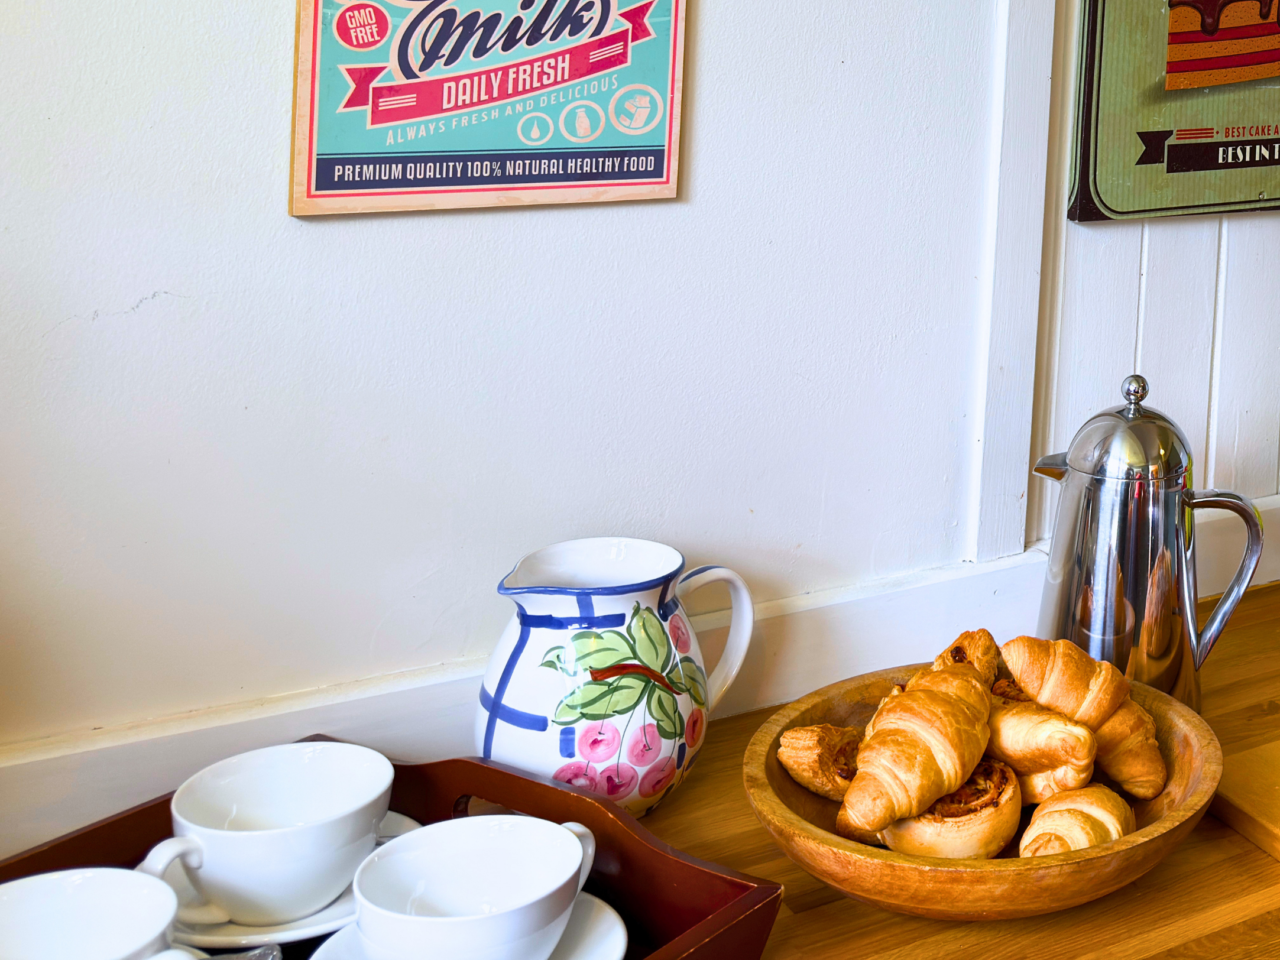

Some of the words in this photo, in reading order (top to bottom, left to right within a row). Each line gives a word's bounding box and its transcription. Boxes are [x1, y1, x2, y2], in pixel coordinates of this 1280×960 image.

[345, 2, 376, 28] GMO
[350, 24, 381, 46] FREE
[442, 70, 503, 110] DAILY
[507, 53, 571, 95] FRESH
[386, 120, 447, 147] ALWAYS
[451, 108, 500, 131] FRESH
[504, 99, 535, 117] AND
[539, 73, 619, 109] DELICIOUS
[1224, 126, 1247, 139] BEST
[1248, 125, 1272, 137] CAKE
[1218, 145, 1252, 164] BEST
[1255, 143, 1270, 161] IN
[334, 164, 403, 182] PREMIUM
[406, 161, 463, 181] QUALITY
[467, 160, 502, 178] 100%
[505, 158, 565, 176] NATURAL
[567, 156, 620, 174] HEALTHY
[623, 155, 655, 172] FOOD
